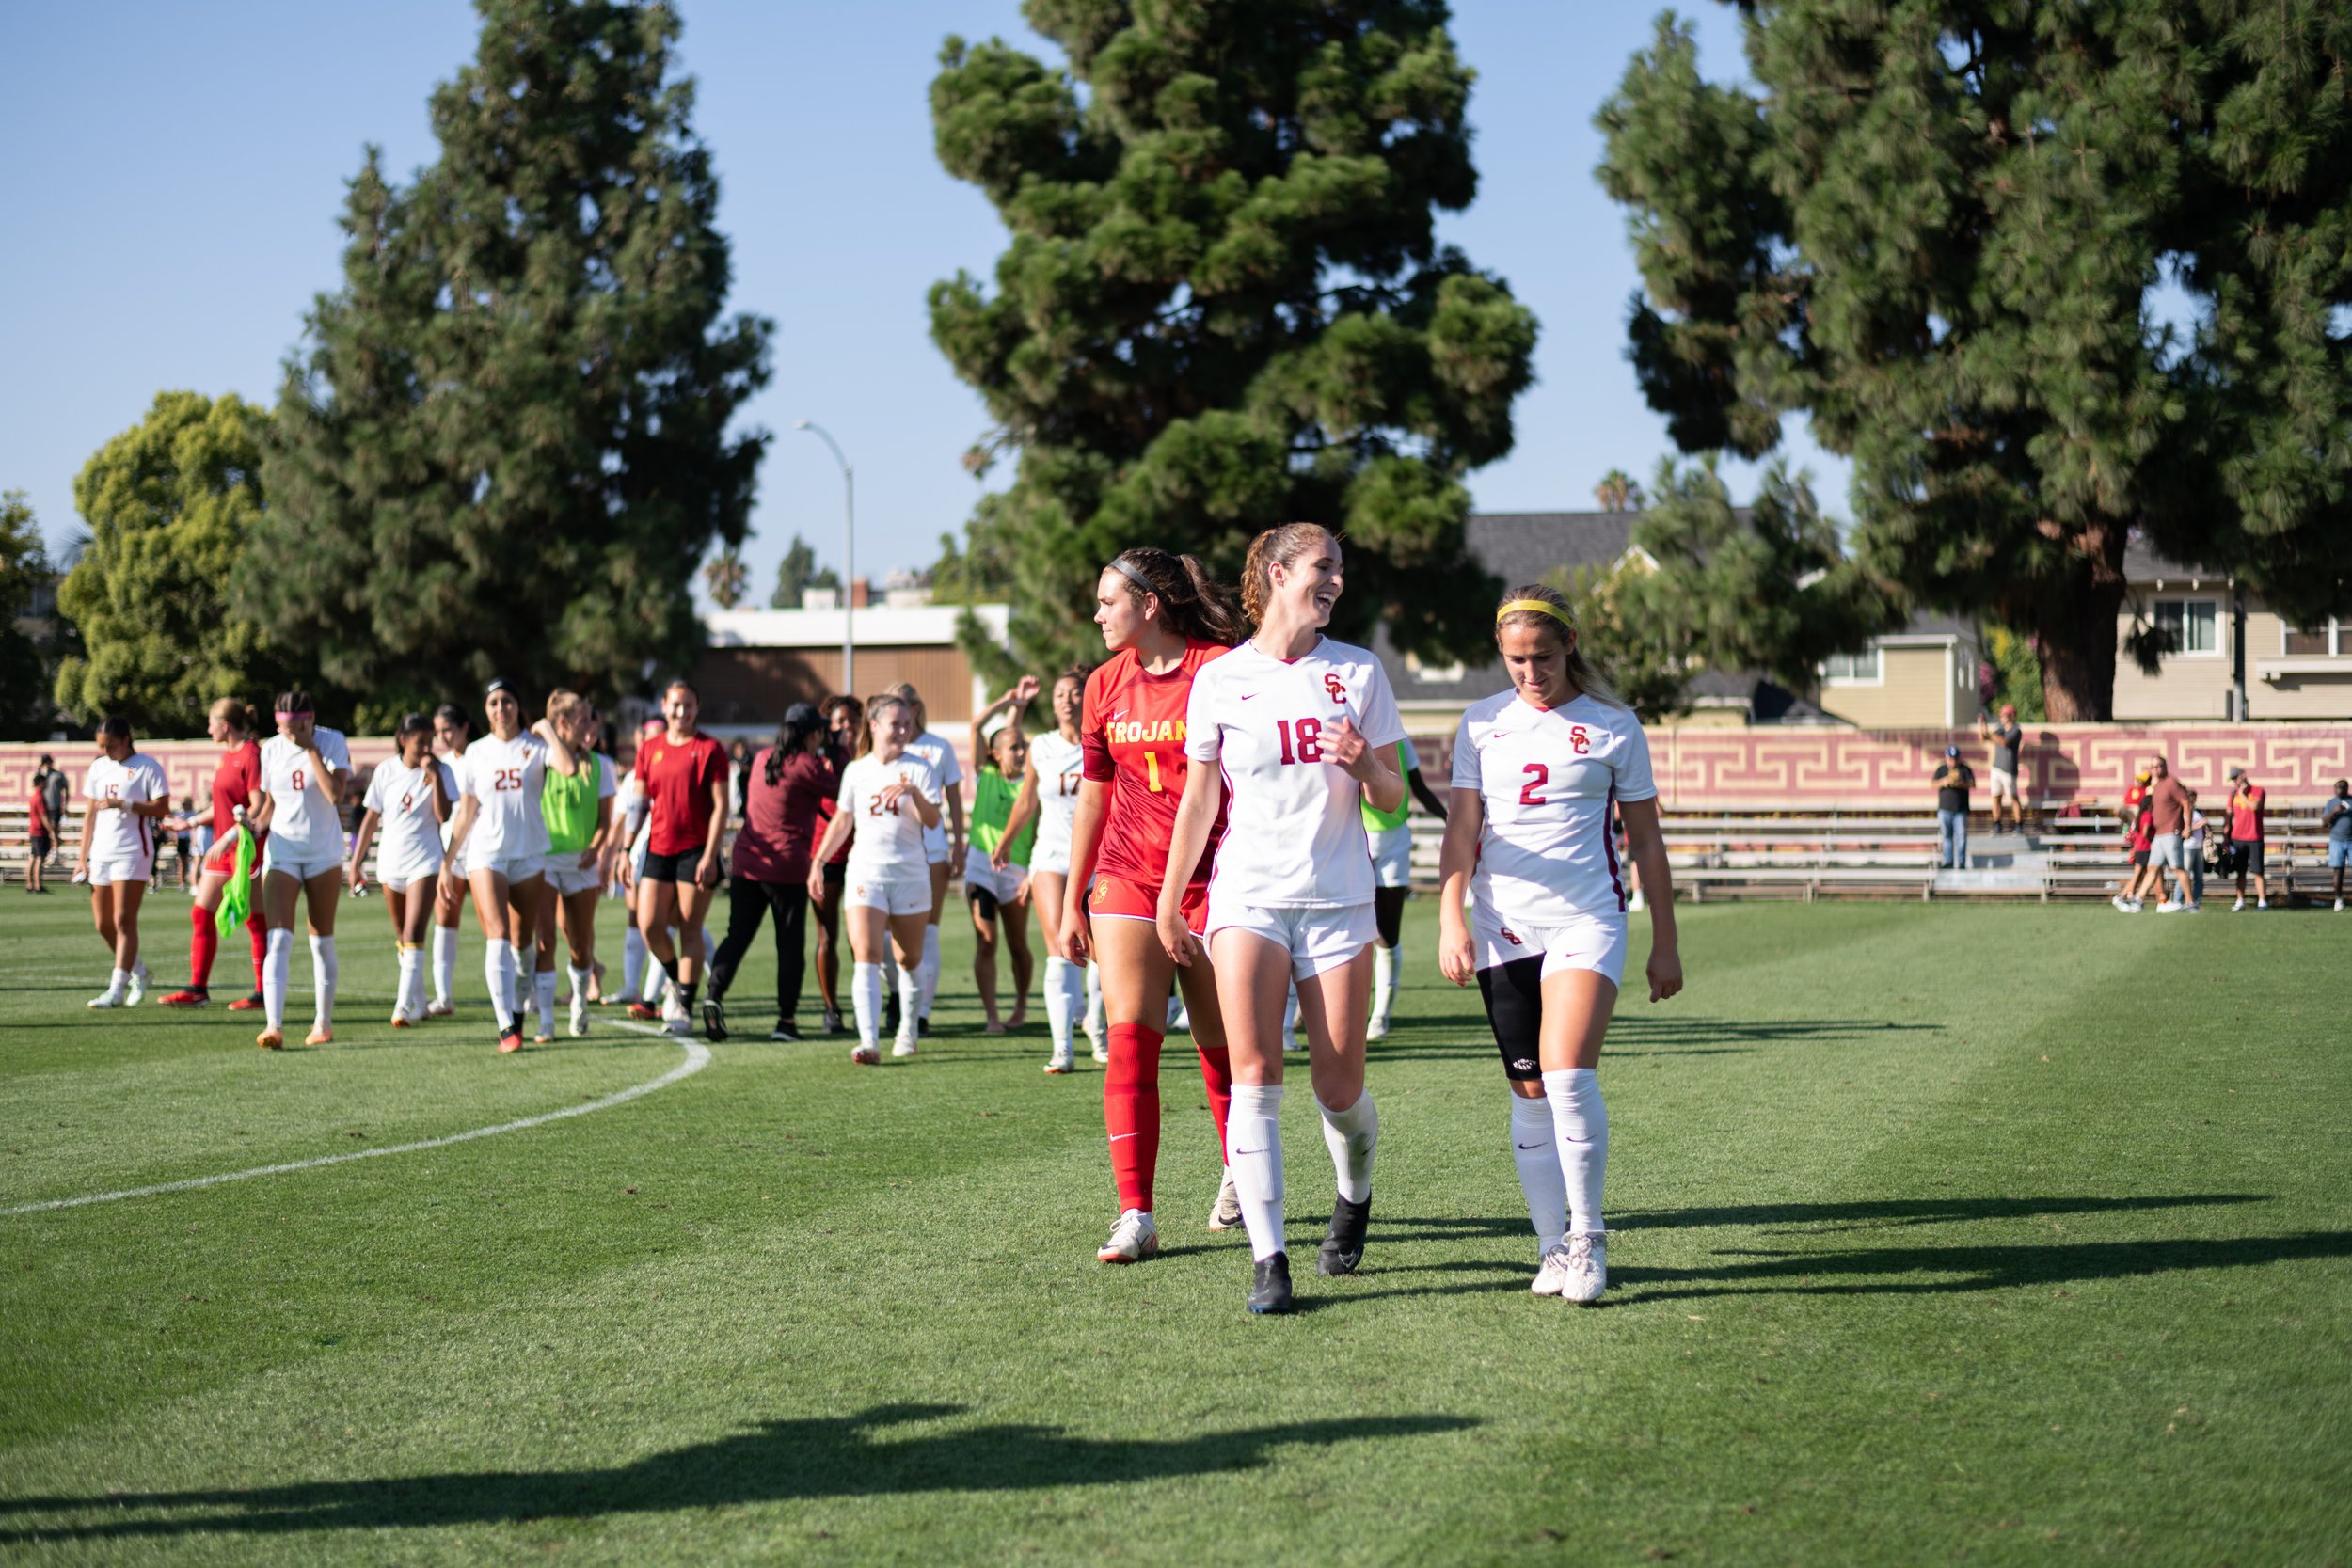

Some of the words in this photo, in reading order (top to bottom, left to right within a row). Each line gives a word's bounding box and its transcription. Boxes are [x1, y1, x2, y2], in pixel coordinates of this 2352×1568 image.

[1325, 673, 1347, 705] SC
[1277, 718, 1324, 766] 18
[1569, 725, 1590, 754] SC
[292, 769, 305, 791] 8
[495, 768, 522, 791] 25
[1059, 773, 1082, 797] 17
[1144, 752, 1163, 793] 1
[1519, 763, 1549, 805] 2
[402, 793, 413, 813] 9
[870, 795, 899, 816] 24
